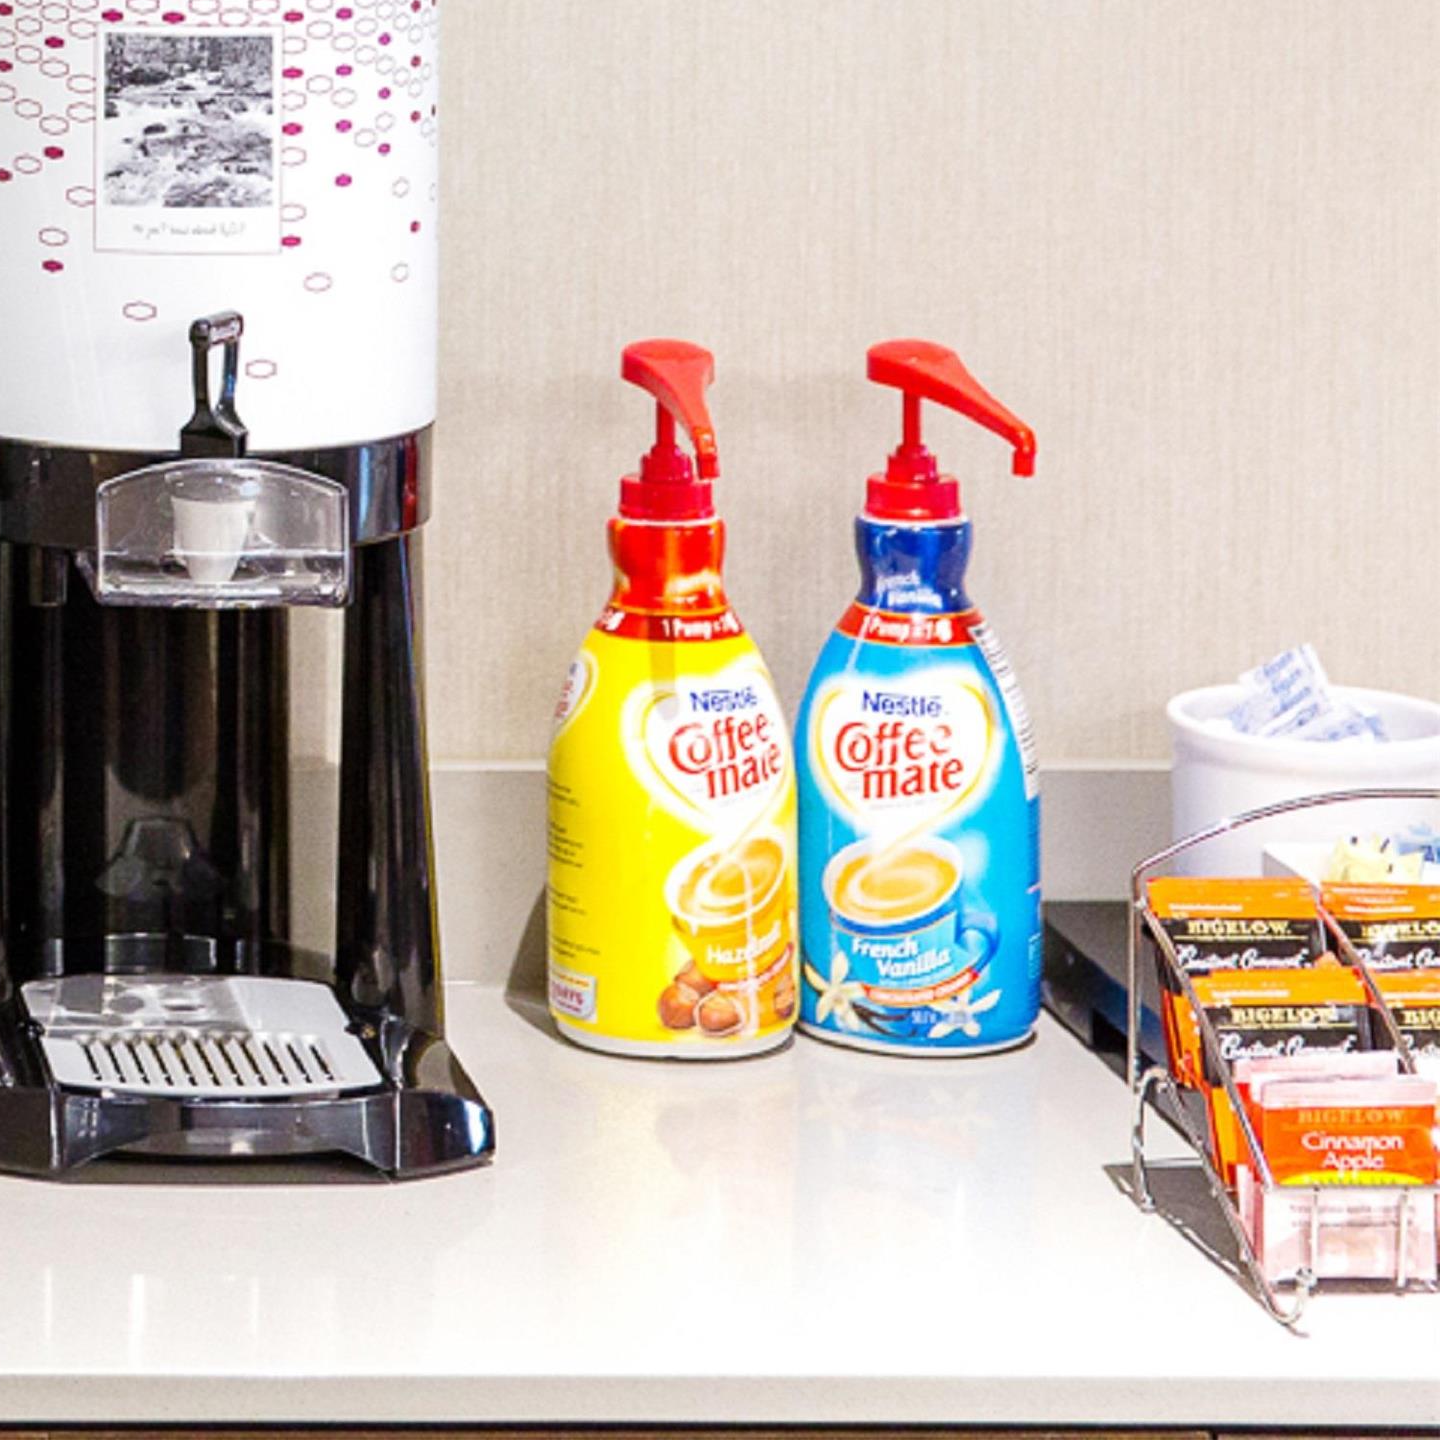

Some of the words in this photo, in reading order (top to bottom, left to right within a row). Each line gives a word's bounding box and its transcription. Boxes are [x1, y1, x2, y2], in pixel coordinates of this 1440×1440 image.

[668, 713, 770, 775] Coffee
[834, 721, 953, 772] Coffee
[707, 743, 782, 799] mate
[862, 758, 964, 799] mate
[851, 935, 919, 959] French
[876, 947, 951, 977] Vanilla
[1298, 1108, 1406, 1125] BIGELOW
[1300, 1130, 1405, 1151] Cinnamon
[1322, 1148, 1385, 1180] Apple
